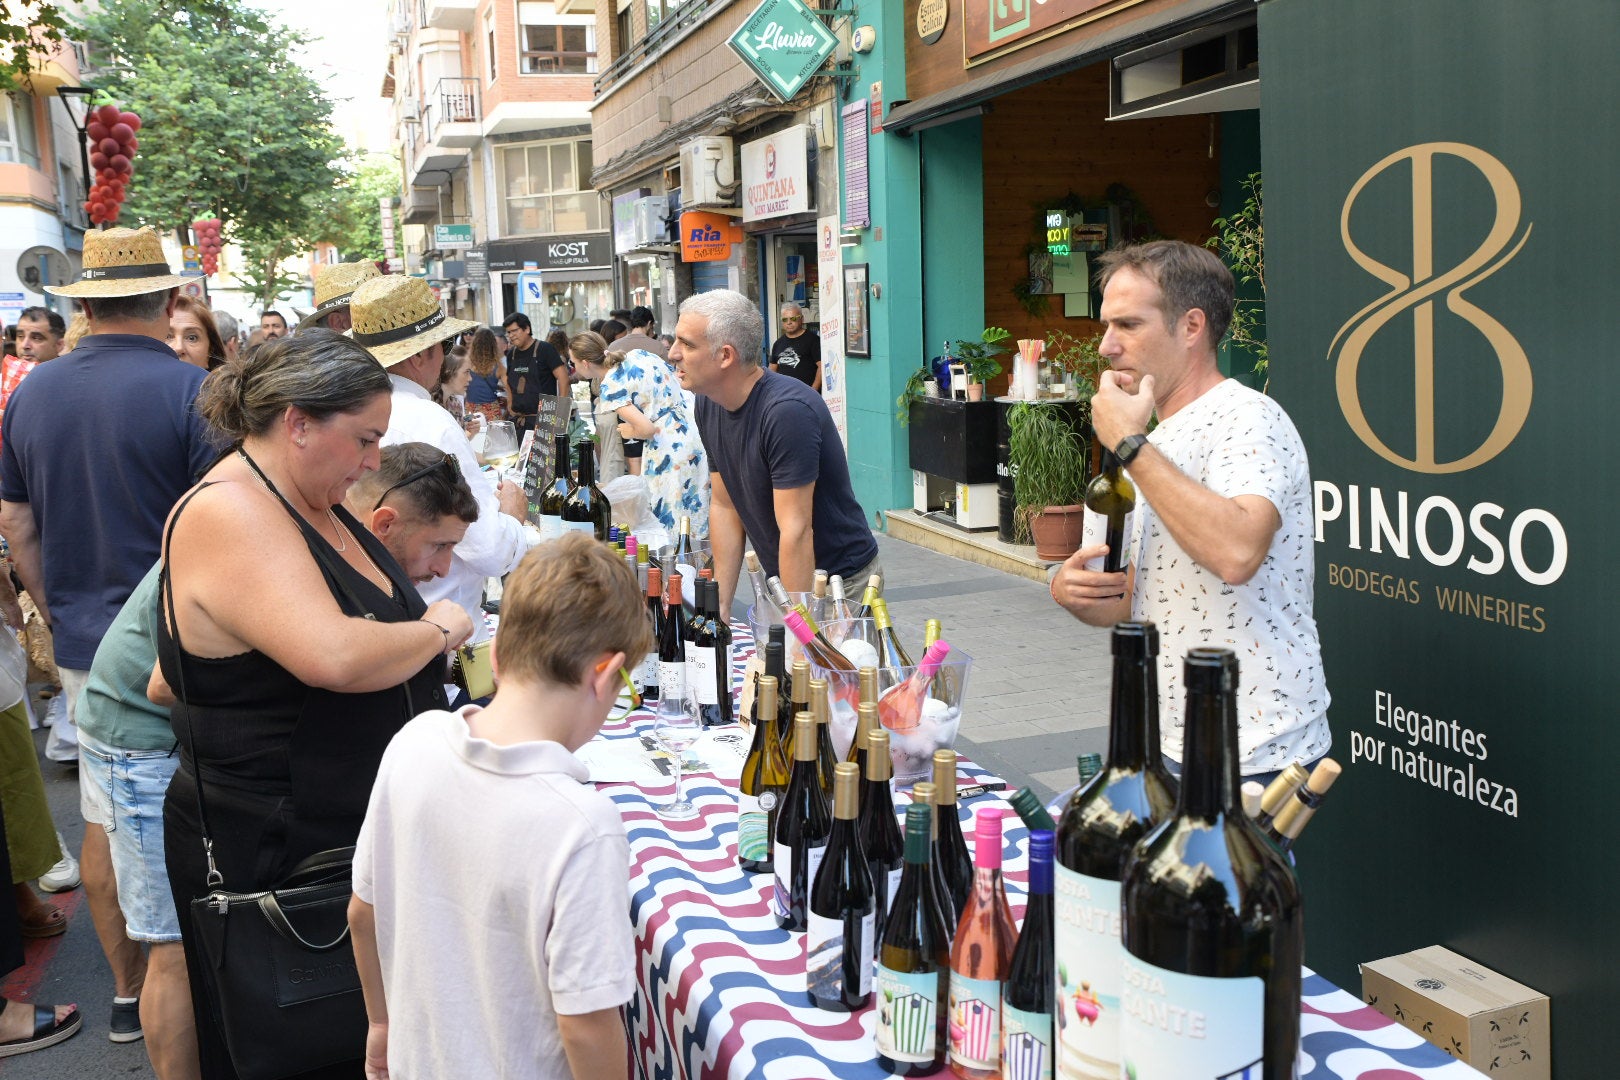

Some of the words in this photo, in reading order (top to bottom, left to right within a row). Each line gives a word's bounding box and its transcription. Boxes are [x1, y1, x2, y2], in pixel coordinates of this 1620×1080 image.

[800, 10, 814, 24] BAR
[754, 21, 817, 51] Lluvia
[756, 56, 773, 74] SOUL
[798, 53, 821, 78] KITCHEN
[747, 177, 796, 205] QUINTANA
[690, 223, 721, 242] Ria
[548, 241, 589, 258] KOST
[1313, 480, 1569, 586] PINOSO
[1328, 563, 1421, 605] BODEGAS
[1436, 585, 1547, 633] WINERIES
[1374, 689, 1488, 761] Elegantes
[1350, 730, 1386, 765] por
[1391, 743, 1519, 818] naturaleza
